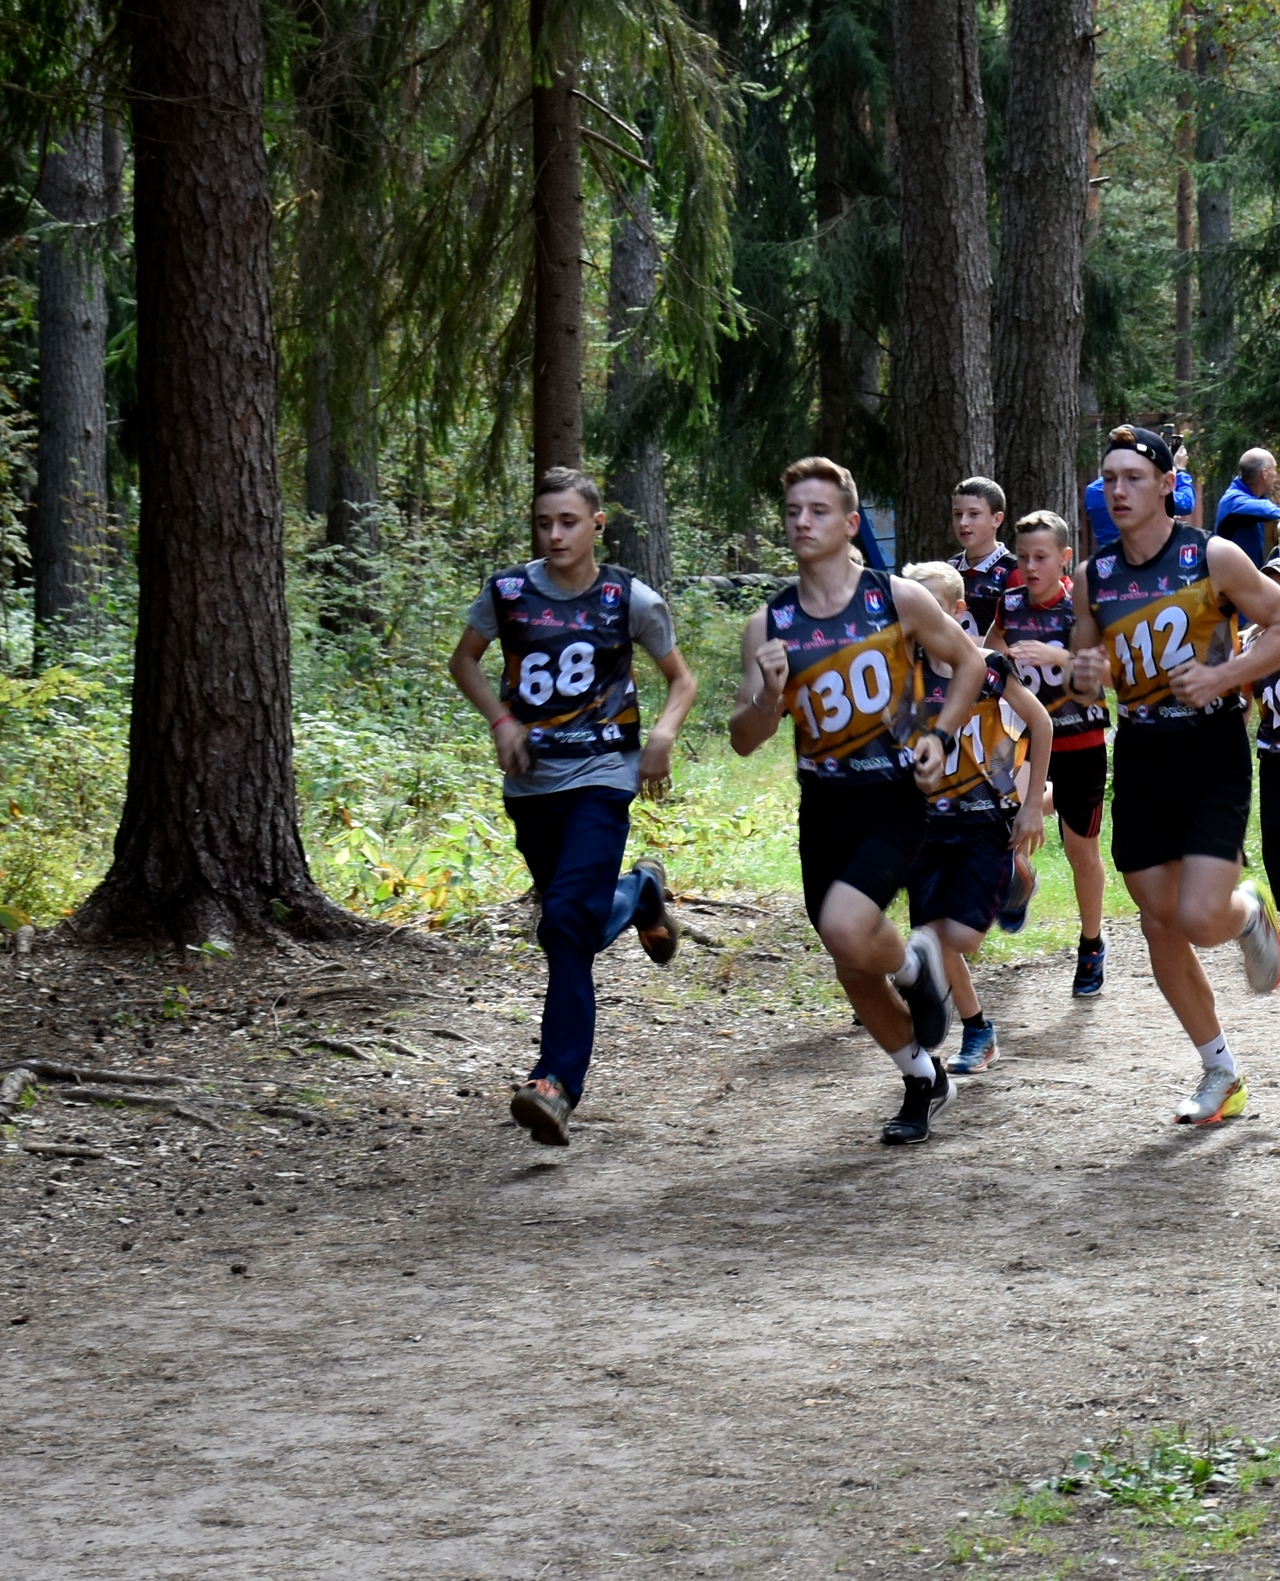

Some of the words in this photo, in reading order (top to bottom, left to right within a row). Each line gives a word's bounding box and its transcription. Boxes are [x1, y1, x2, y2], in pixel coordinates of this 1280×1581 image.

[519, 641, 596, 706] 68
[1115, 605, 1196, 686] 112
[795, 649, 892, 740] 130
